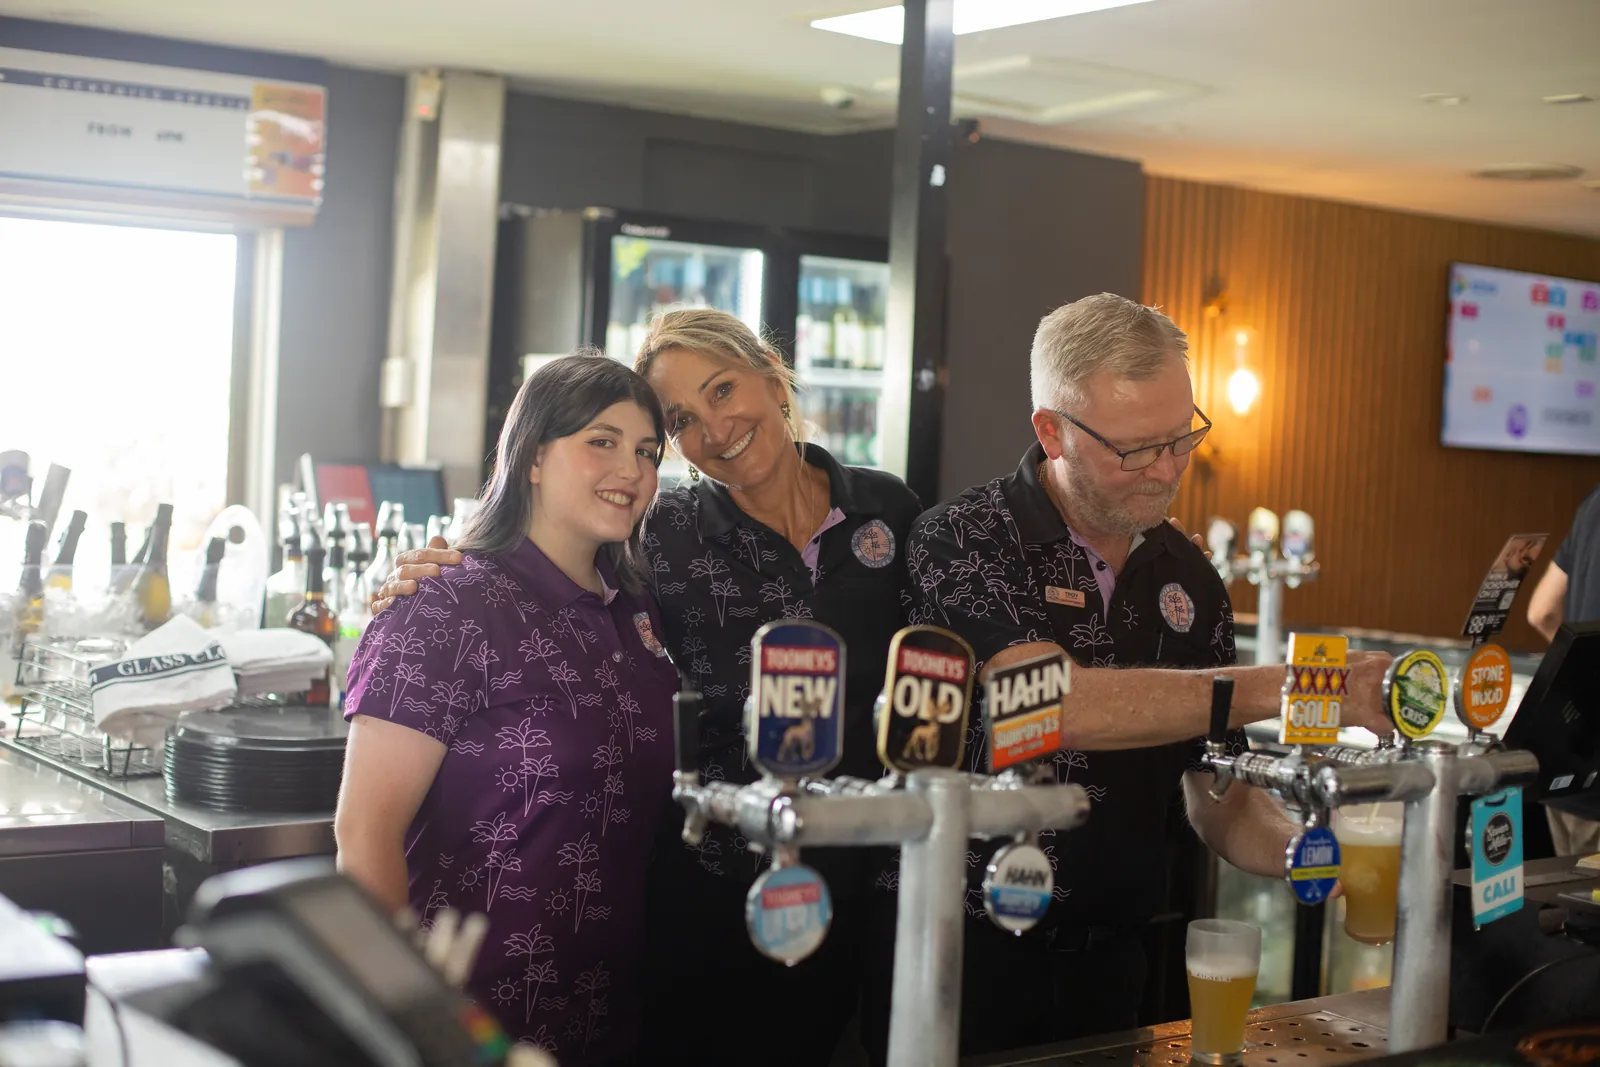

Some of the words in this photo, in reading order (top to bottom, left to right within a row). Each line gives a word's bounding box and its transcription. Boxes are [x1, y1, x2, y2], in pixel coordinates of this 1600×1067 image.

[1483, 580, 1520, 589] SCHOONER
[117, 655, 186, 676] GLASS
[766, 648, 835, 671] TOOHEYS
[902, 650, 965, 680] TOOHEYS
[1290, 665, 1351, 696] XXXX
[1471, 664, 1505, 686] STONE
[760, 675, 837, 718] NEW
[893, 675, 964, 724] OLD
[989, 660, 1071, 718] HAHN
[1471, 687, 1503, 707] WOOD
[1290, 700, 1341, 728] GOLD
[1400, 705, 1430, 727] CRISP
[1301, 846, 1334, 866] LEMON
[1005, 866, 1049, 887] HAHN
[1483, 876, 1516, 904] CALI
